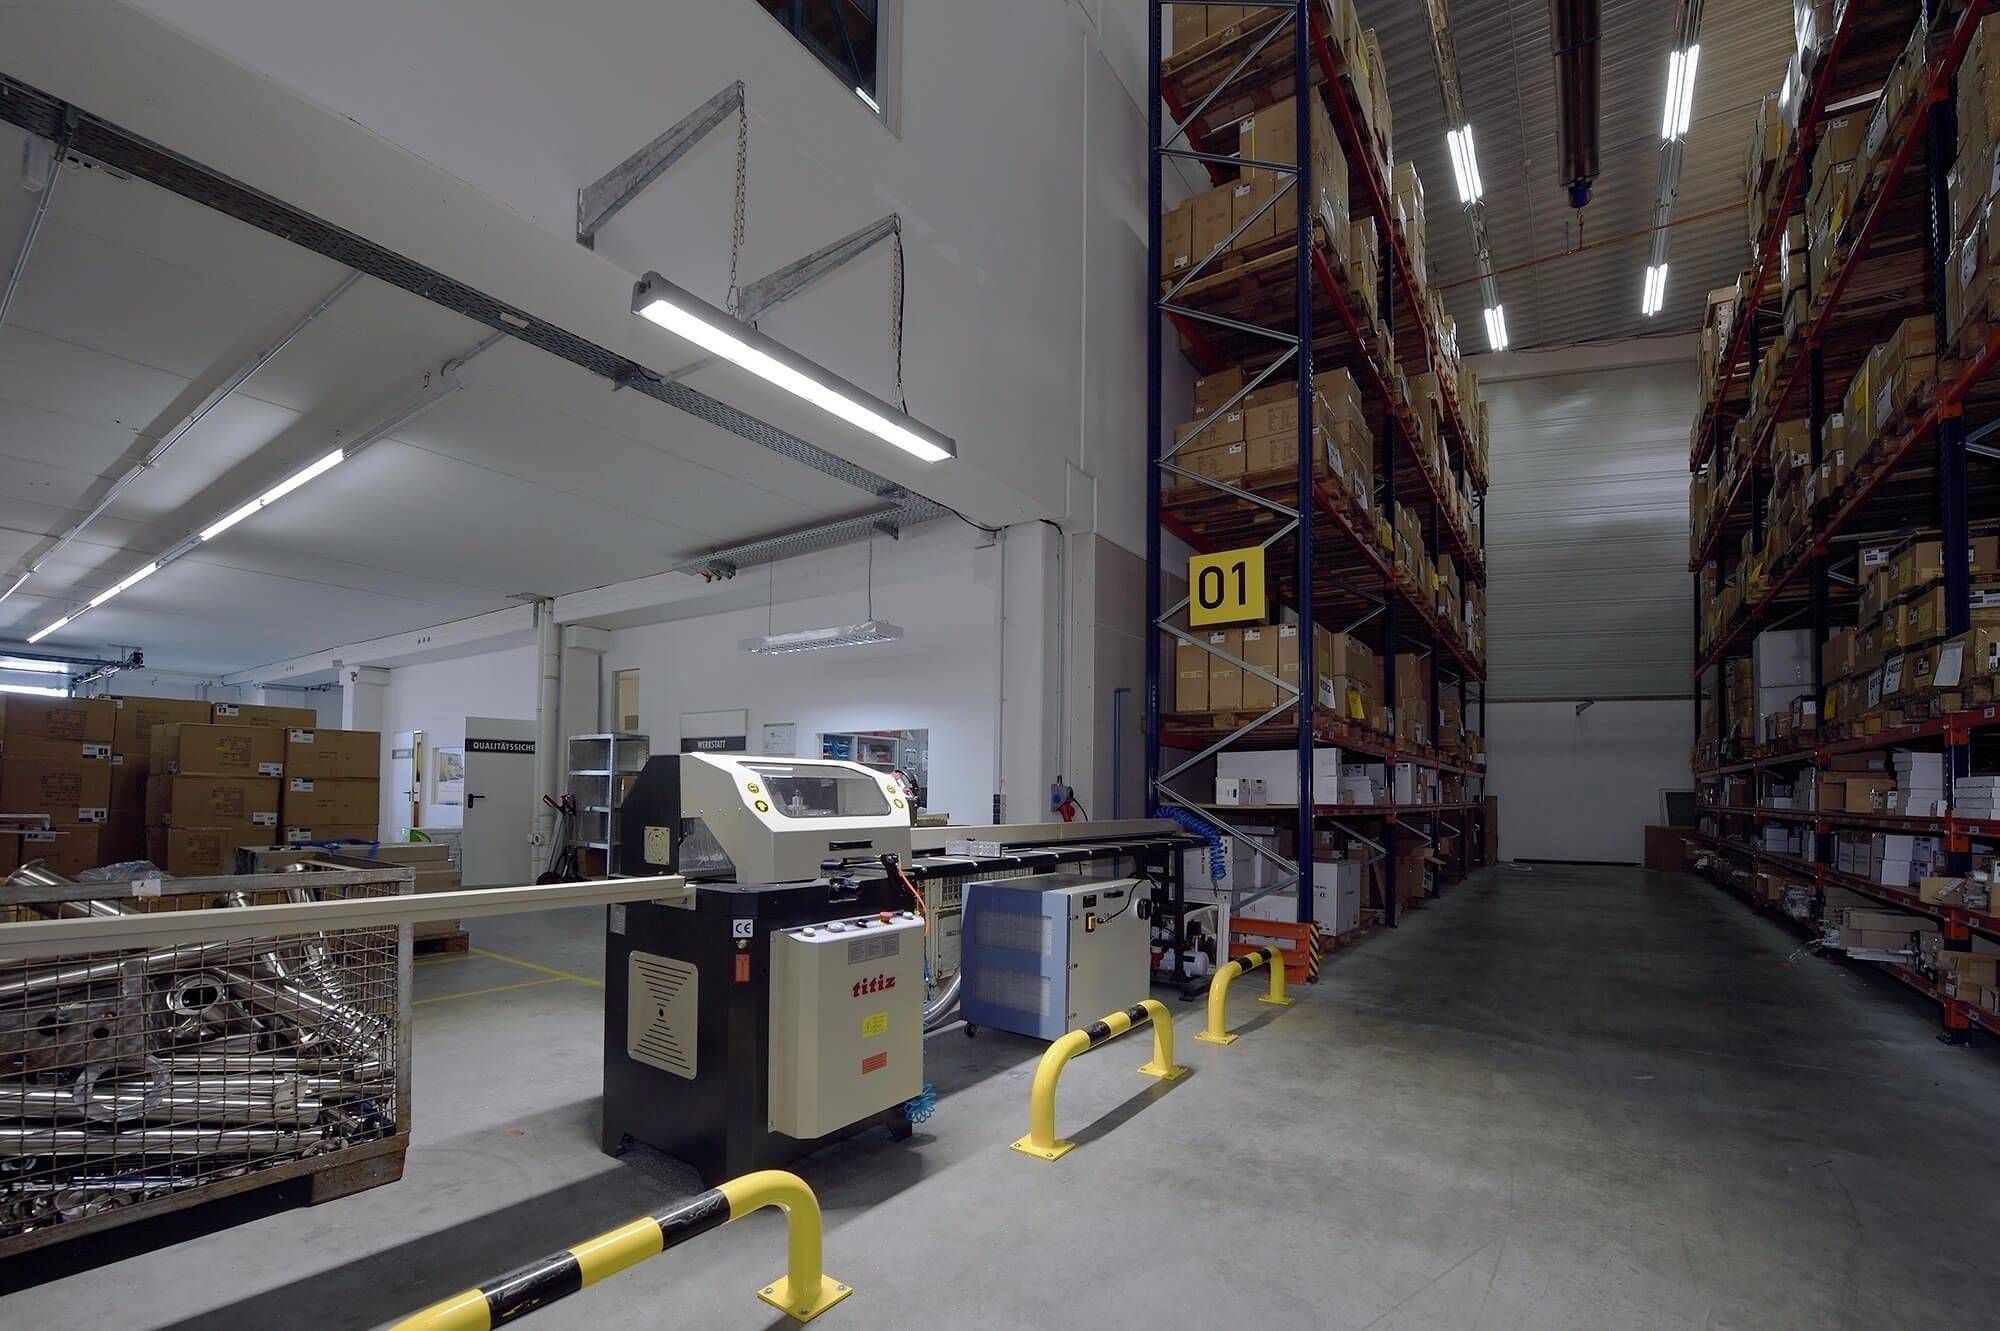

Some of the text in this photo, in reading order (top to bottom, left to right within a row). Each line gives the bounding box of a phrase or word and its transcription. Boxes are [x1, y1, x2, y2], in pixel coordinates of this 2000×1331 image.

[1199, 561, 1246, 609] 01
[735, 922, 751, 934] CE
[852, 974, 896, 998] titiz
